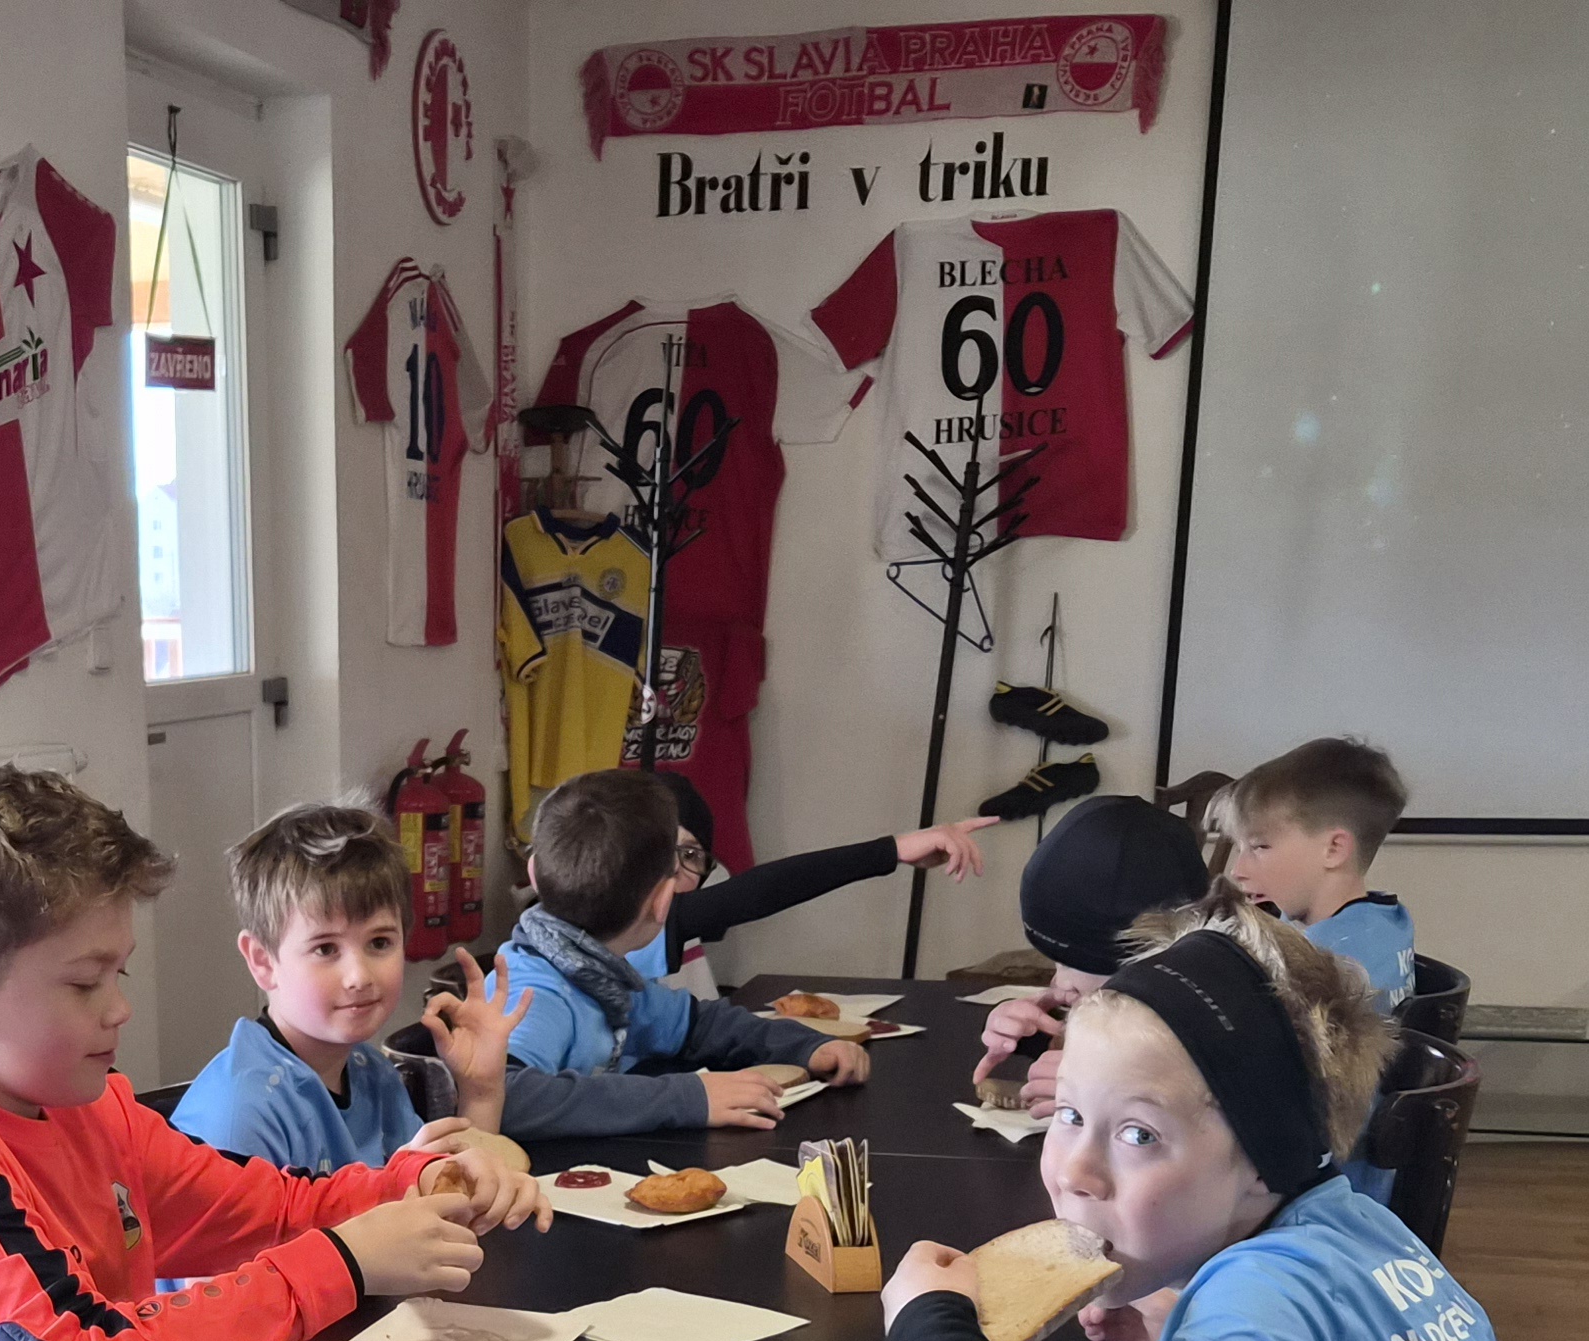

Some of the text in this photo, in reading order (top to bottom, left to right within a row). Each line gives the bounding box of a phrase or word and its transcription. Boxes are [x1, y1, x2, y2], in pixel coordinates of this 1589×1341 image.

[687, 22, 1057, 82] SK SLAVIA PRAHA
[775, 76, 952, 126] FOTBAL
[656, 131, 1049, 218] Bratři v triku
[938, 254, 1069, 288] BLECHA
[150, 347, 212, 379] ZAVŘENO
[941, 291, 1065, 401] 60
[406, 343, 446, 465] 10
[934, 407, 1068, 445] HRUSICE
[619, 387, 729, 489] 60
